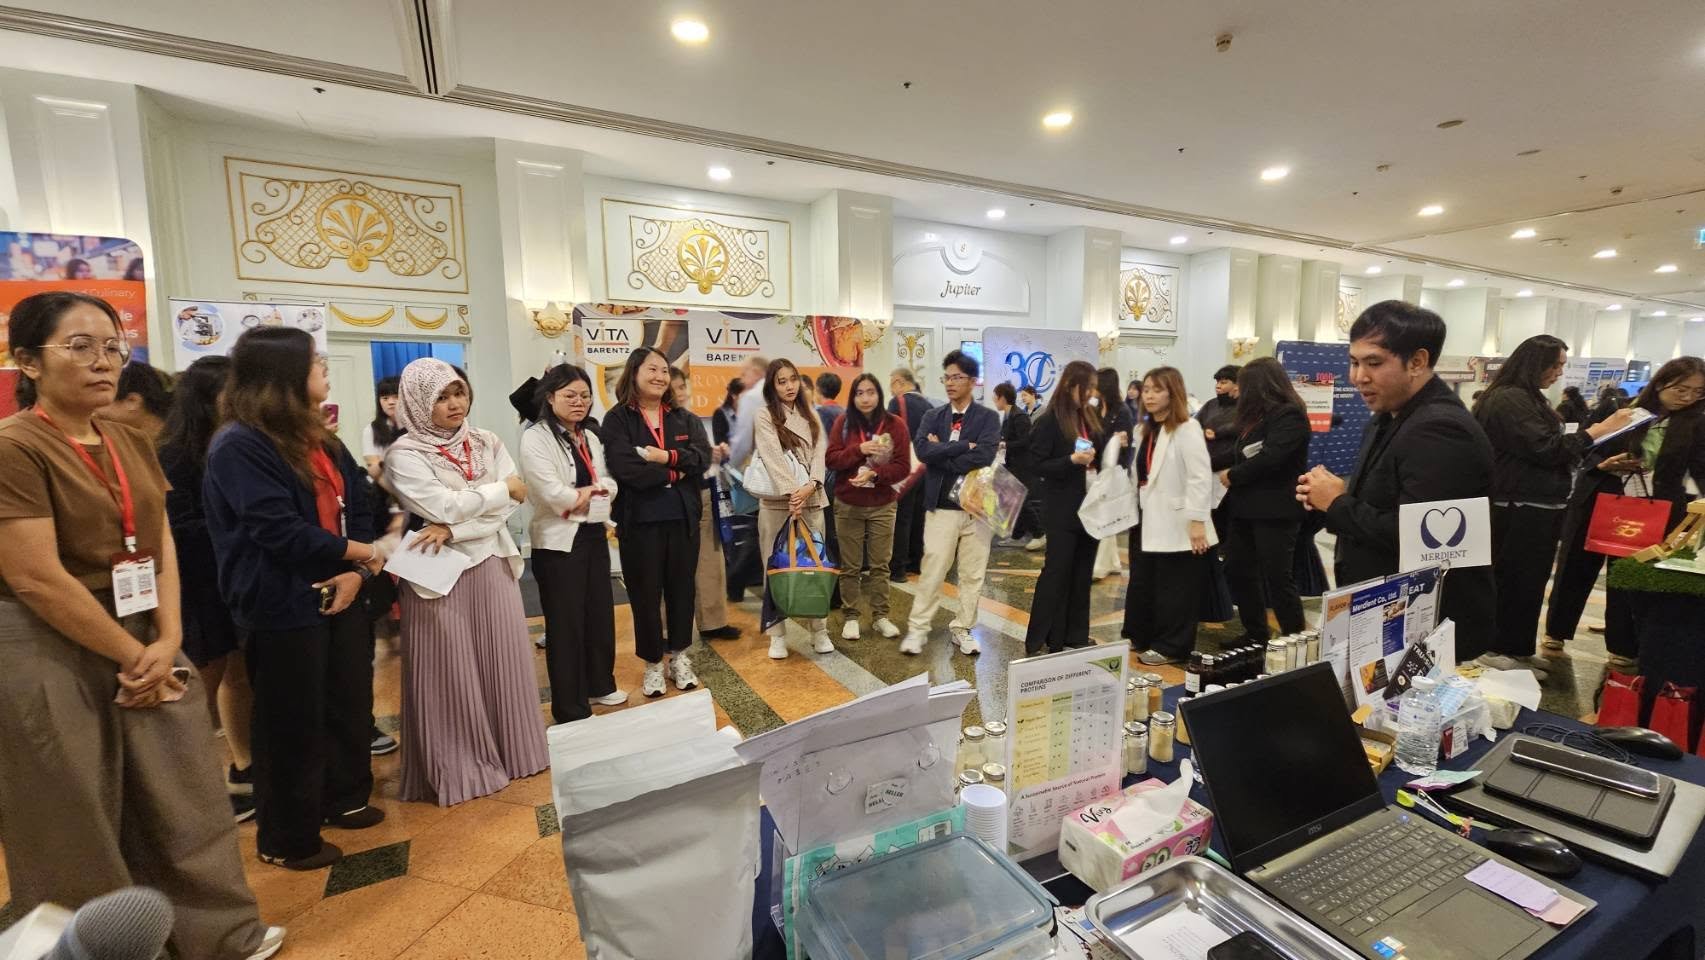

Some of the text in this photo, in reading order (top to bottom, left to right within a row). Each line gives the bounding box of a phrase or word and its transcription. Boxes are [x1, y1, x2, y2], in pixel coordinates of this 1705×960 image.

[940, 280, 981, 298] Jupiter
[586, 321, 630, 341] VITA
[706, 319, 760, 345] VITA
[1420, 549, 1468, 562] MERDIENT
[1020, 677, 1057, 688] COMPARISON
[1065, 669, 1092, 680] DIFFERENT
[1020, 684, 1047, 694] PROTEINS
